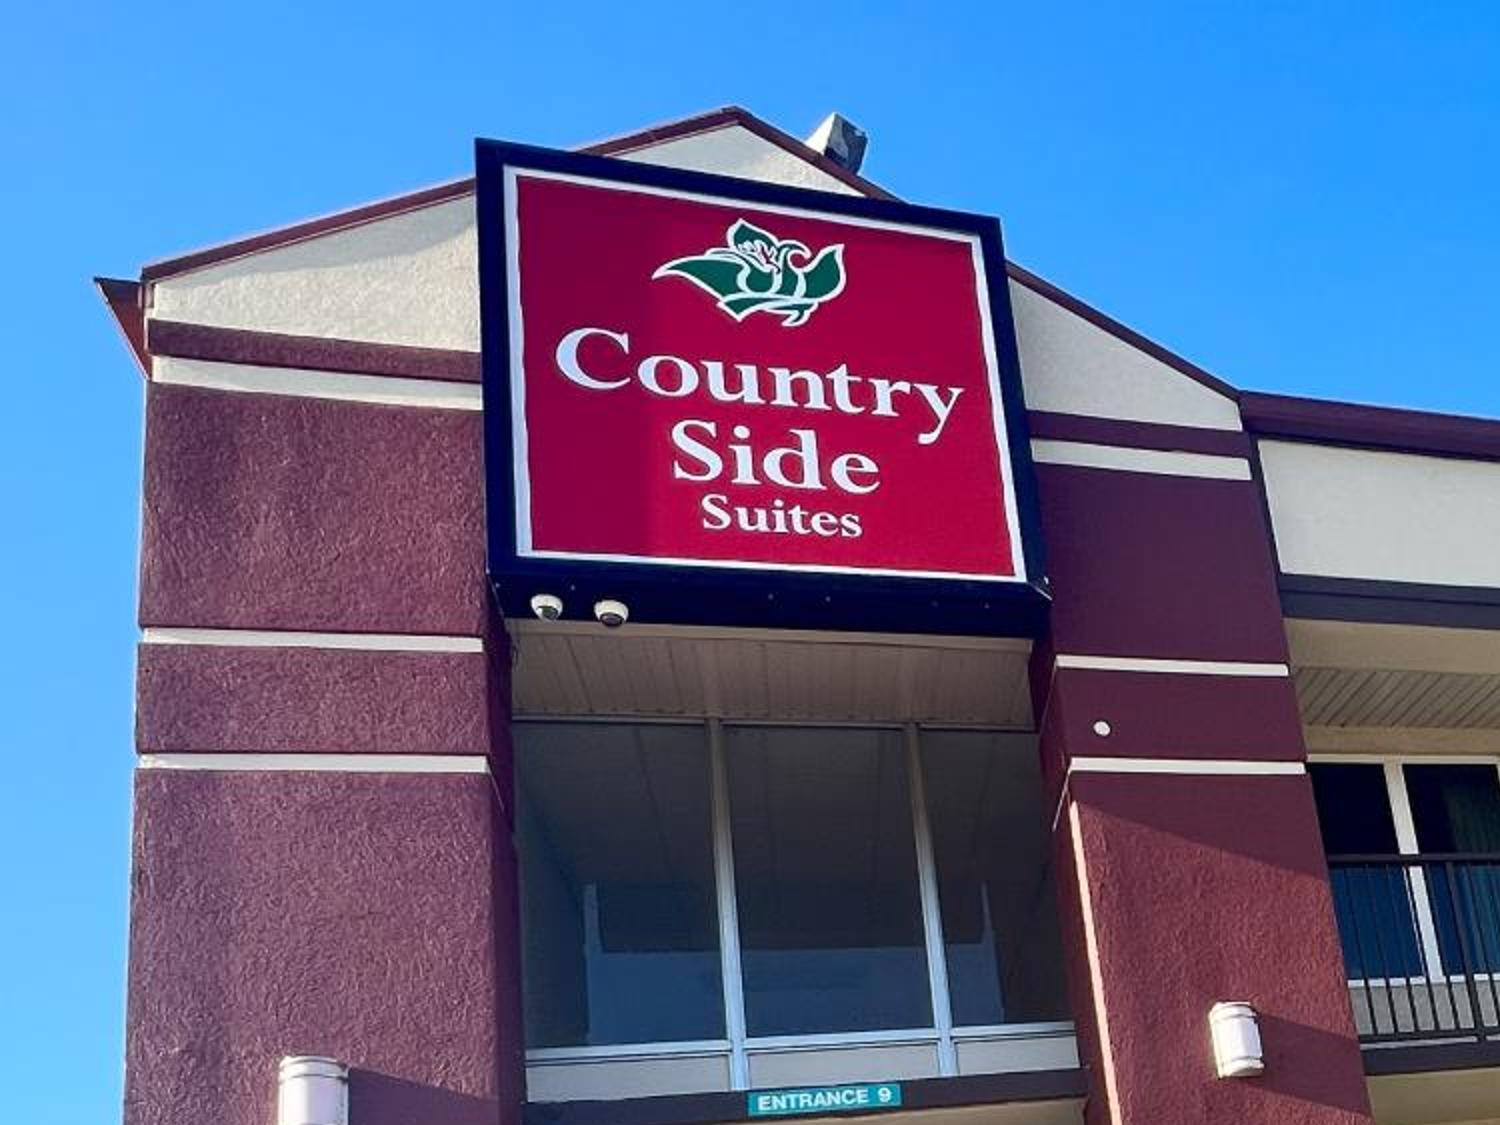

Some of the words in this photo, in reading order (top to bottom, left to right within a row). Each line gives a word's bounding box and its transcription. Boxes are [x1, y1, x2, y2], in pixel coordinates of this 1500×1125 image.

[555, 327, 965, 445] Country
[671, 420, 881, 494] Side
[701, 494, 863, 537] Suites
[757, 1088, 869, 1111] ENTRANCE
[877, 1087, 892, 1103] 9
